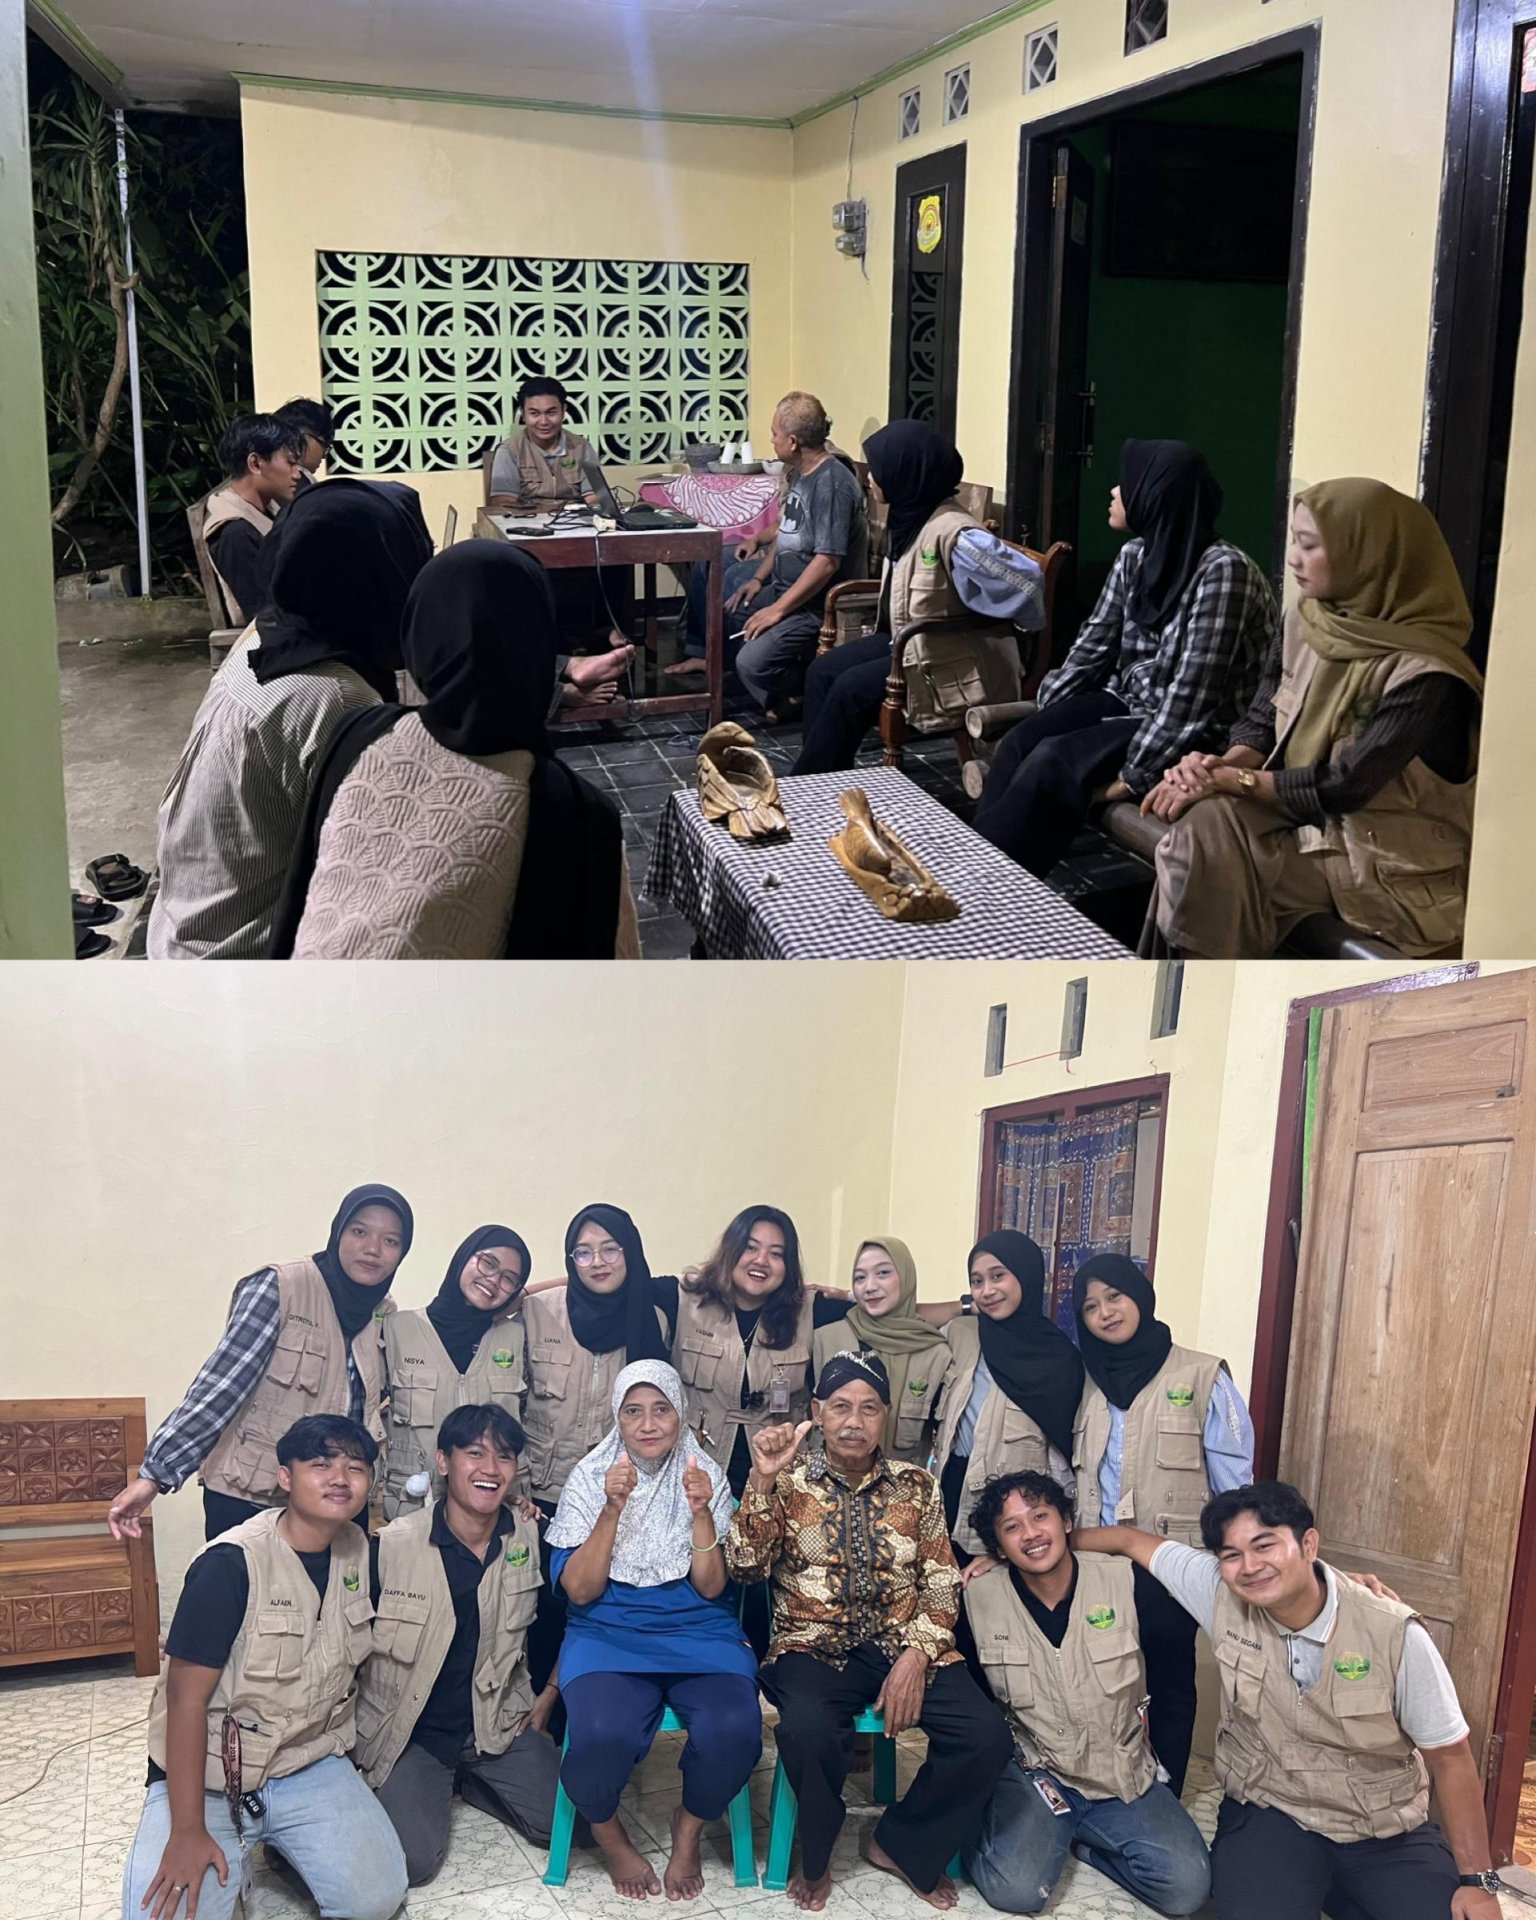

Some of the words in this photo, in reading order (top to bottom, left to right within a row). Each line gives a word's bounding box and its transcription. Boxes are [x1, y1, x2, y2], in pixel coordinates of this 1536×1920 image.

[404, 1357, 425, 1365] NISYA
[384, 1589, 405, 1597] DAFFA
[407, 1592, 426, 1601] BAYU
